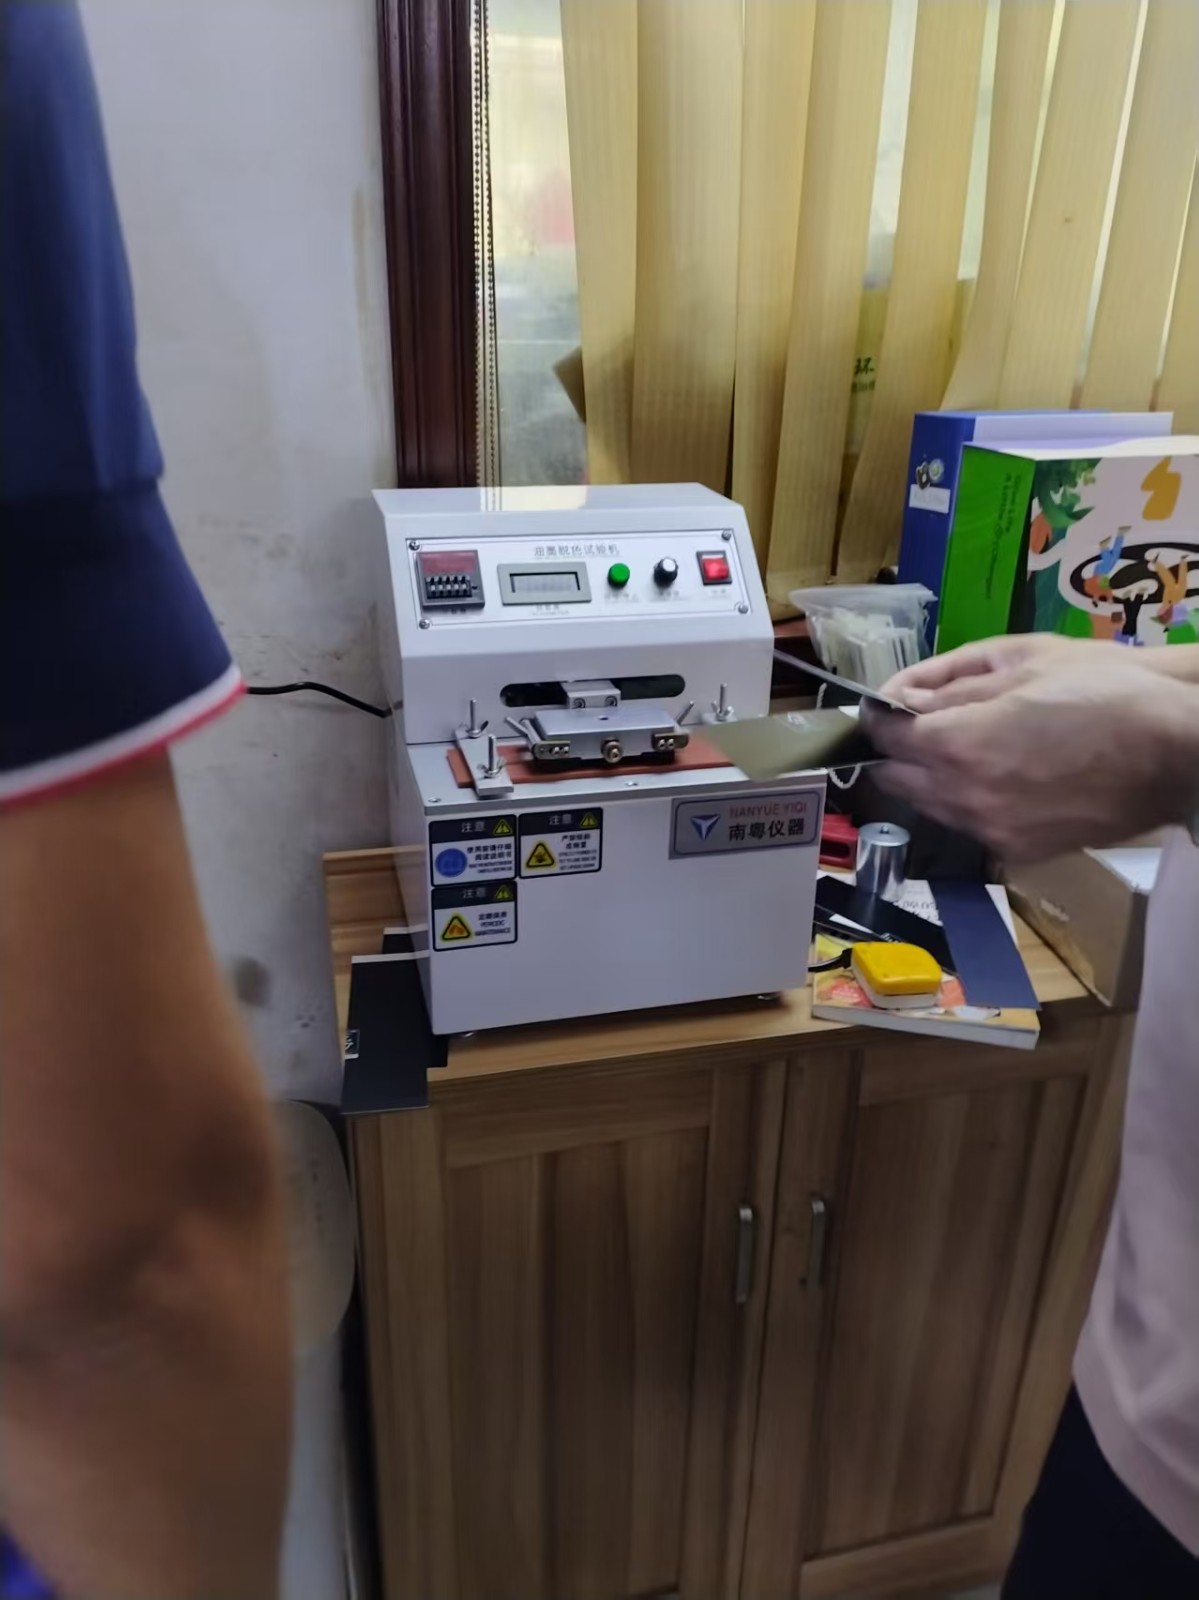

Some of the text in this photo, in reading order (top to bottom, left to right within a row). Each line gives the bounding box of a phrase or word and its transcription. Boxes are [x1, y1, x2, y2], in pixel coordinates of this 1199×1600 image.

[729, 801, 807, 819] NANYUE YIQI
[461, 821, 485, 832] 注意
[549, 814, 572, 825] 注意
[729, 818, 805, 841] 南粤仪器
